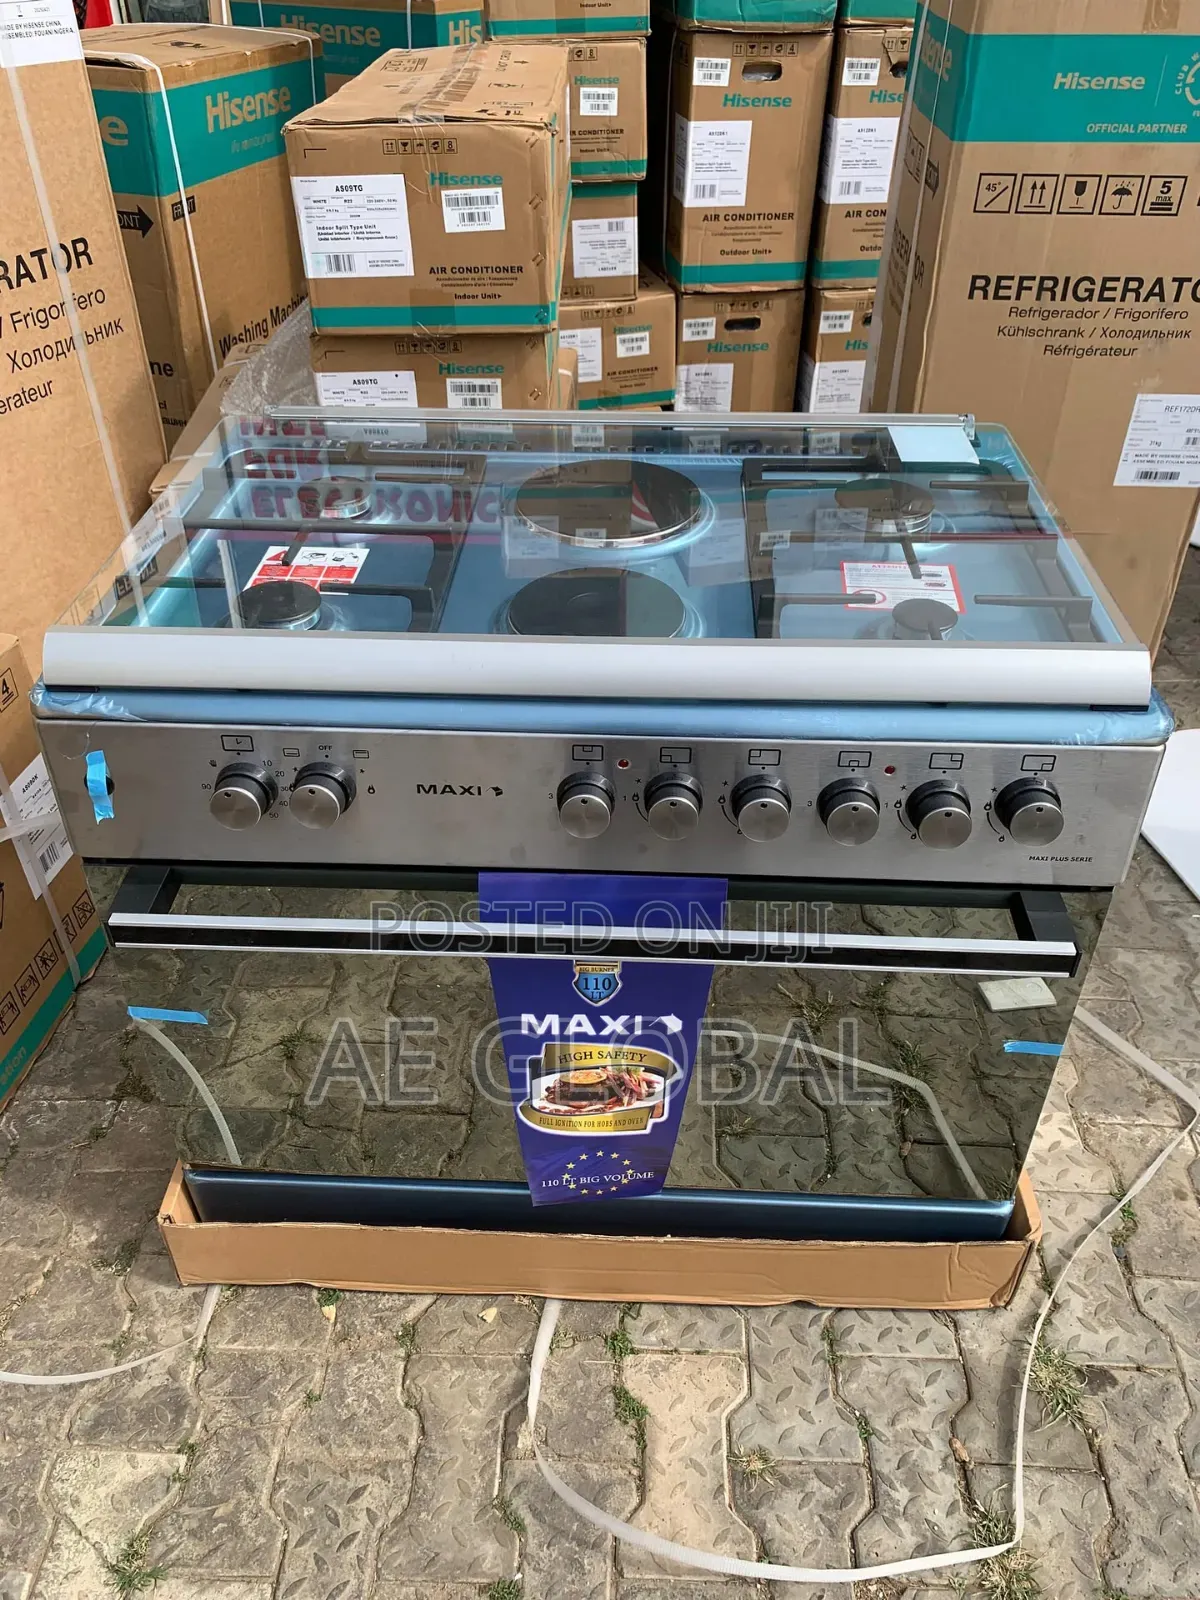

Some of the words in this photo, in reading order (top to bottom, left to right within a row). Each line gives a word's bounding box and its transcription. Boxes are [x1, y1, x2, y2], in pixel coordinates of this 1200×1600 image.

[280, 14, 381, 47] Hisense
[574, 76, 619, 86] Hisense
[1053, 72, 1145, 91] Hisense
[722, 93, 793, 108] Hisense
[204, 86, 291, 134] Hisense
[1086, 123, 1135, 134] OFFICIAL
[1137, 123, 1188, 134] PARTNER
[430, 172, 503, 187] Hisense
[335, 185, 363, 193] AS09TG
[1160, 180, 1172, 194] 5
[702, 213, 720, 222] AIR
[723, 212, 795, 222] CONDITIONER
[845, 210, 862, 218] AIR
[429, 267, 447, 275] AIR
[450, 265, 524, 274] CONDITIONER
[1008, 306, 1100, 320] Refrigerador
[1103, 308, 1111, 319] /
[1114, 307, 1189, 321] Frigorifero
[219, 317, 269, 359] Washing
[997, 325, 1085, 339] Kühlschrank
[1089, 327, 1096, 338] /
[1099, 327, 1191, 340] Холодильник
[707, 341, 769, 353] Hisense
[1043, 345, 1138, 359] Réfrigérateur
[438, 363, 505, 375] Hisense
[262, 759, 272, 767] 10
[201, 783, 212, 791] 90
[416, 783, 482, 796] MAXI
[548, 792, 554, 800] 3
[278, 799, 289, 807] 40
[268, 811, 279, 819] 50
[583, 977, 612, 991] 110
[591, 990, 604, 1000] LT
[521, 1013, 642, 1036] MAXI
[559, 1051, 593, 1065] HIGH
[597, 1050, 648, 1063] SAFETY
[538, 1116, 554, 1126] FULL
[554, 1117, 582, 1128] IGNITION
[583, 1118, 596, 1128] FOR
[613, 1117, 627, 1127] AND
[541, 1178, 560, 1188] 110
[562, 1176, 577, 1186] LT
[579, 1175, 600, 1185] BIG
[603, 1171, 655, 1184] VOLUME
